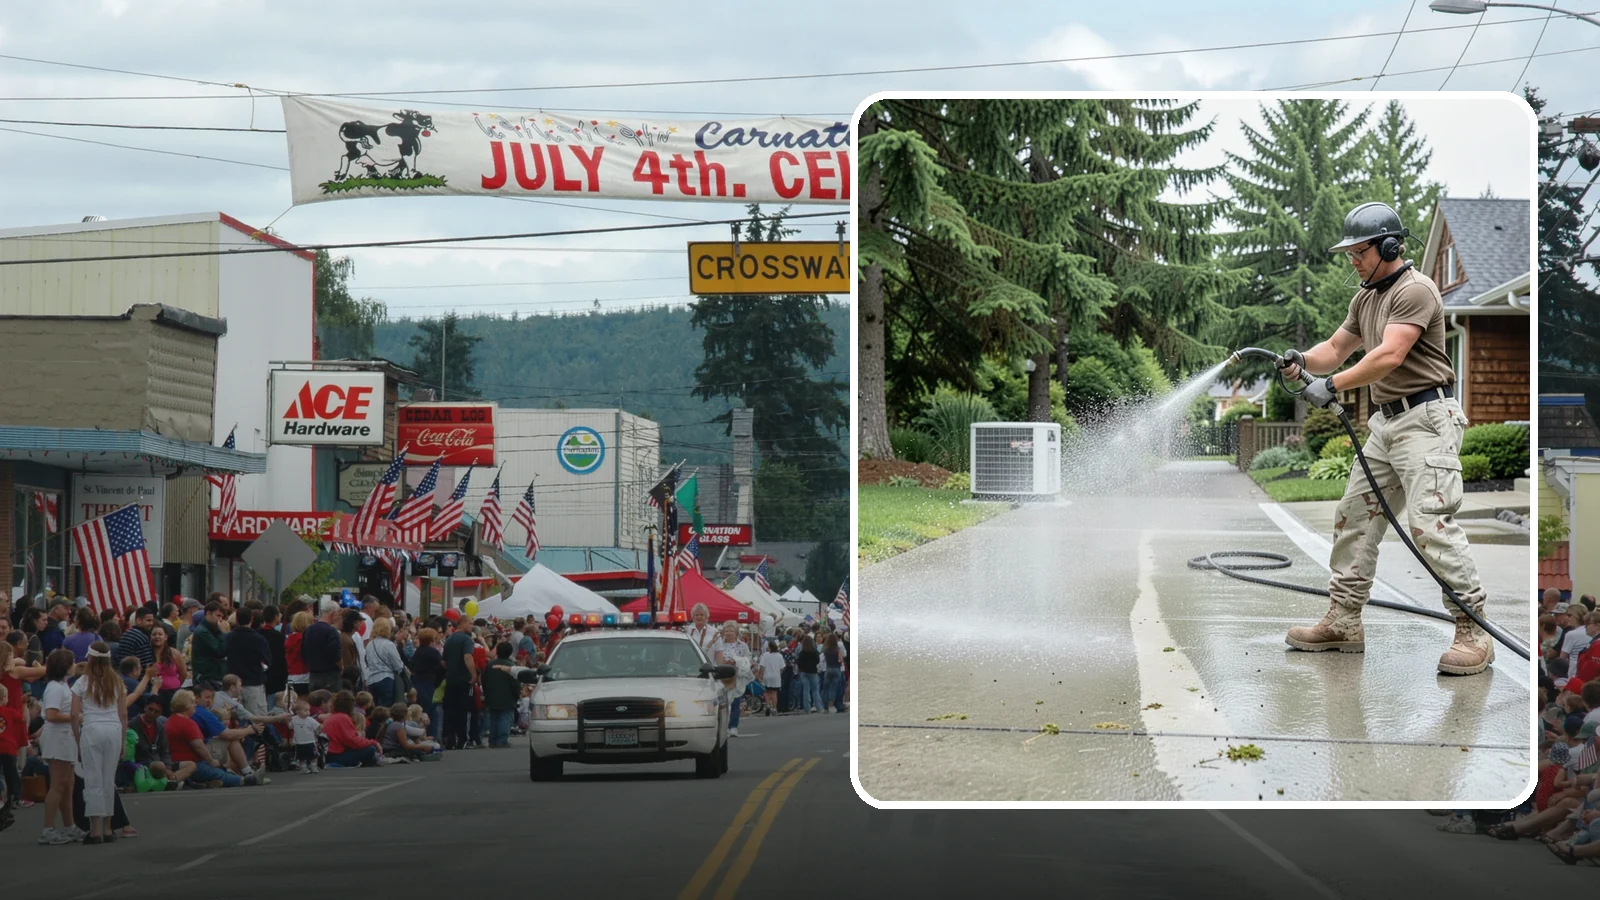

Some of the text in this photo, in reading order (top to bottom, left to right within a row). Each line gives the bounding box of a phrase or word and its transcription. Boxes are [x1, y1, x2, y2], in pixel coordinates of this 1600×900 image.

[481, 141, 604, 193] JULY
[632, 150, 746, 198] 4th.
[697, 255, 850, 280] CROSSWA
[283, 380, 373, 420] ACE
[405, 409, 485, 422] CEDAR LOG
[283, 421, 370, 436] Hardware
[416, 428, 477, 446] Coca-Cola
[353, 467, 387, 480] Simpl
[95, 485, 124, 495] Vincent
[126, 486, 136, 495] de
[138, 486, 155, 495] Paul
[688, 526, 742, 535] CRNATION
[699, 535, 730, 544] GLASS
